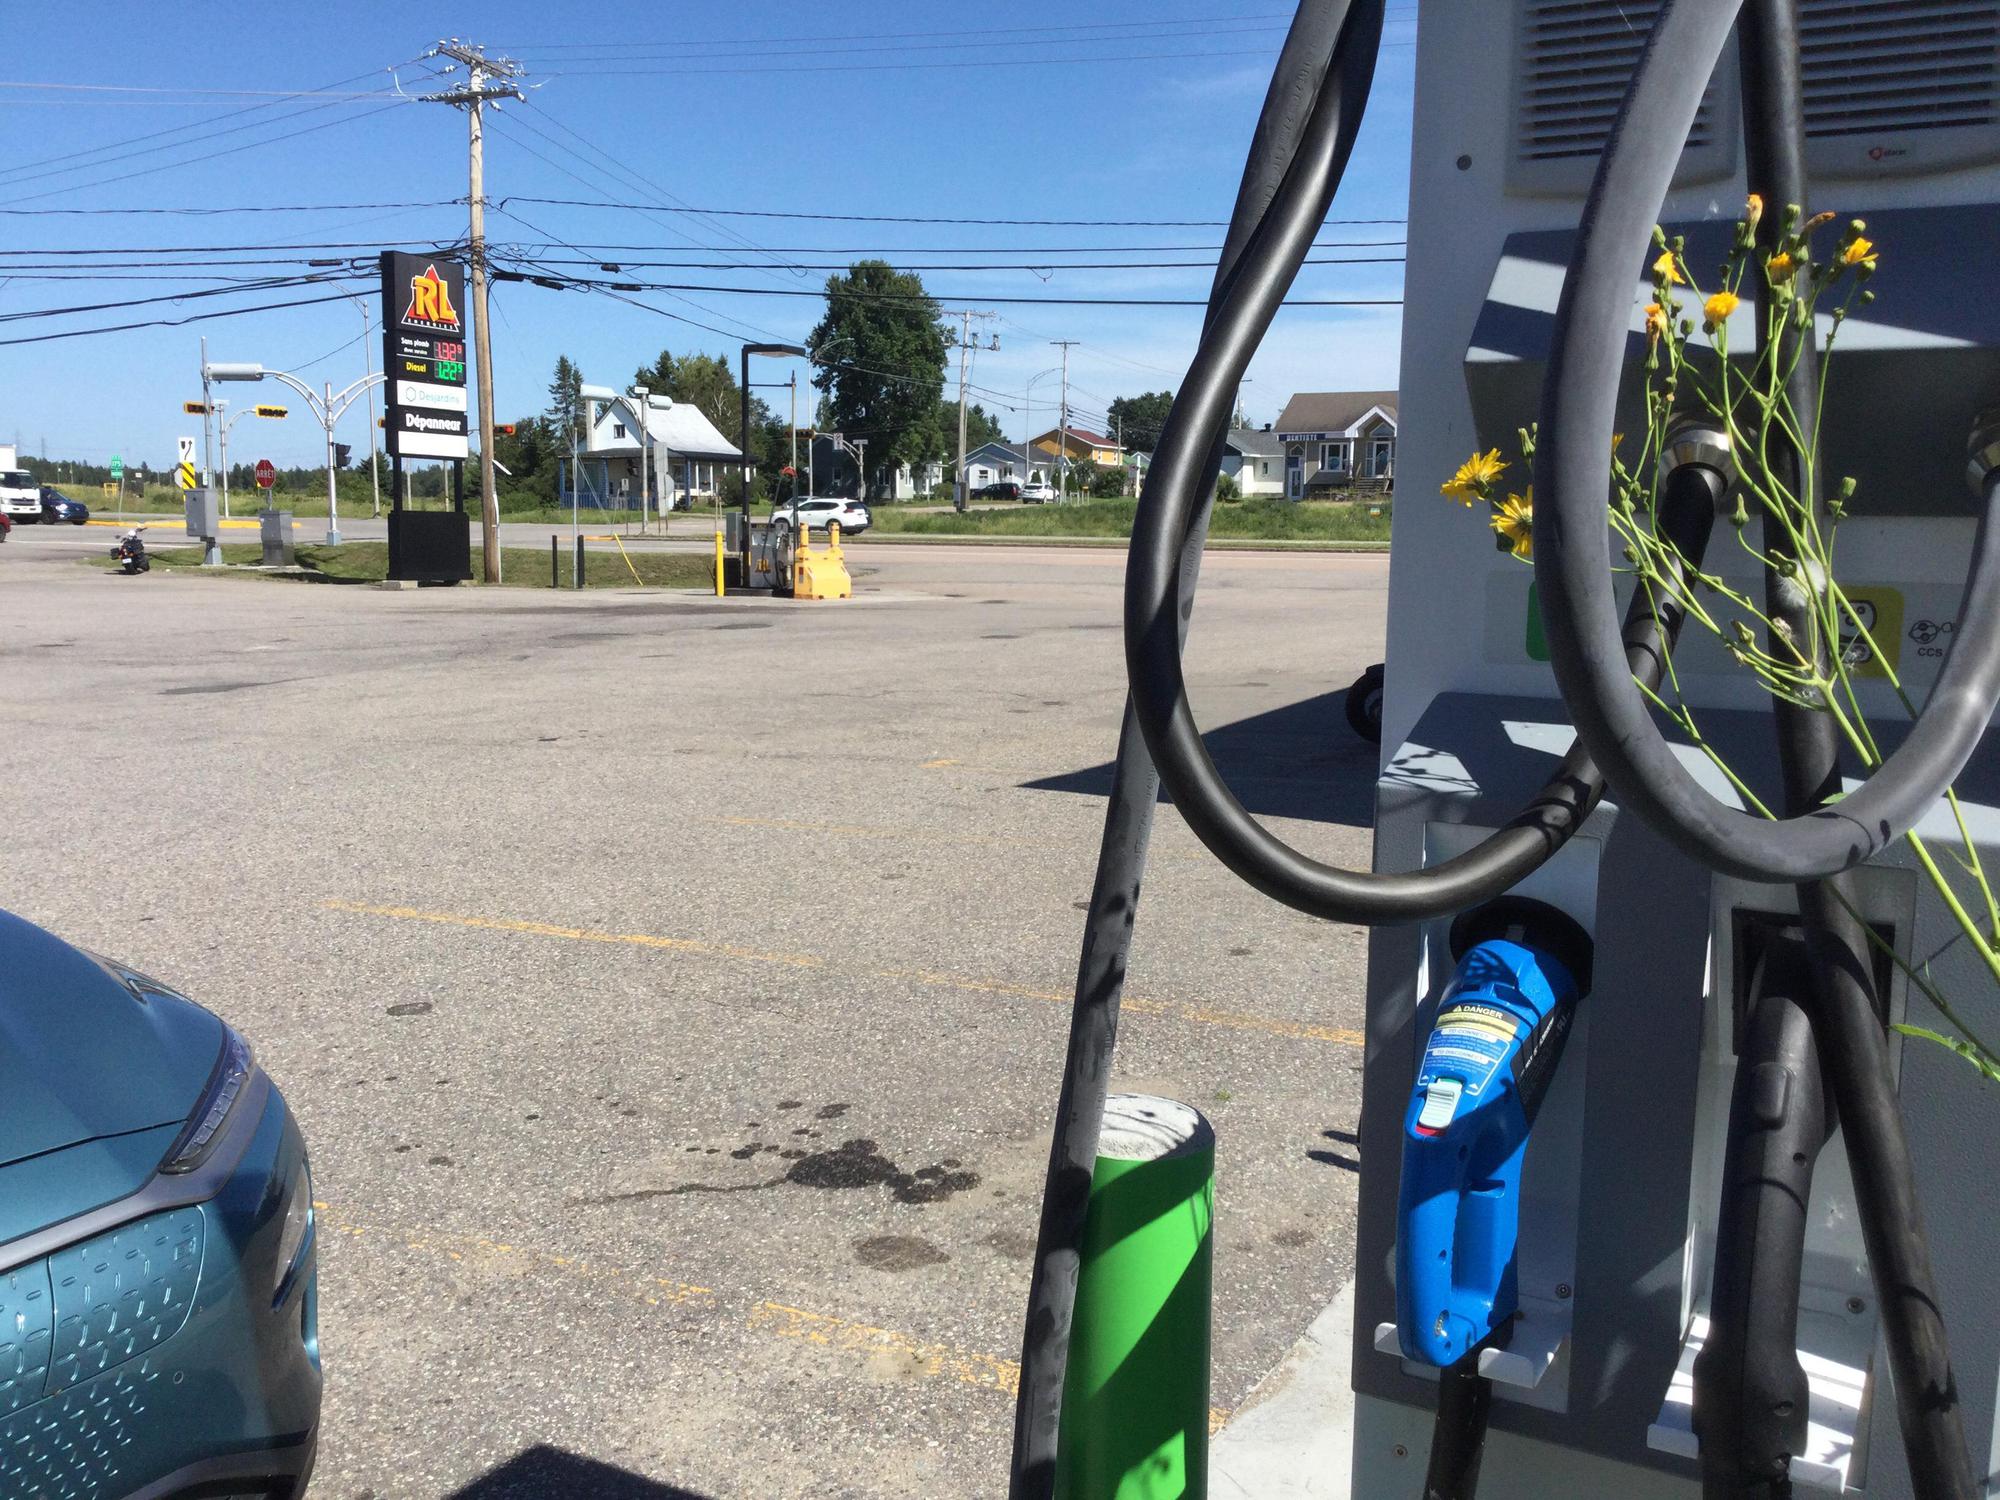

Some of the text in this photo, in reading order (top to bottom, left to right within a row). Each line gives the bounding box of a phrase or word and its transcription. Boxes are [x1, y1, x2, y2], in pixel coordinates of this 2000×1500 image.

[414, 276, 456, 323] RL
[406, 362, 426, 373] Diesel
[420, 391, 460, 404] Desjardins
[406, 413, 461, 431] Dépanneur
[1917, 648, 1943, 657] CCS
[1463, 1005, 1504, 1020] DANGER
